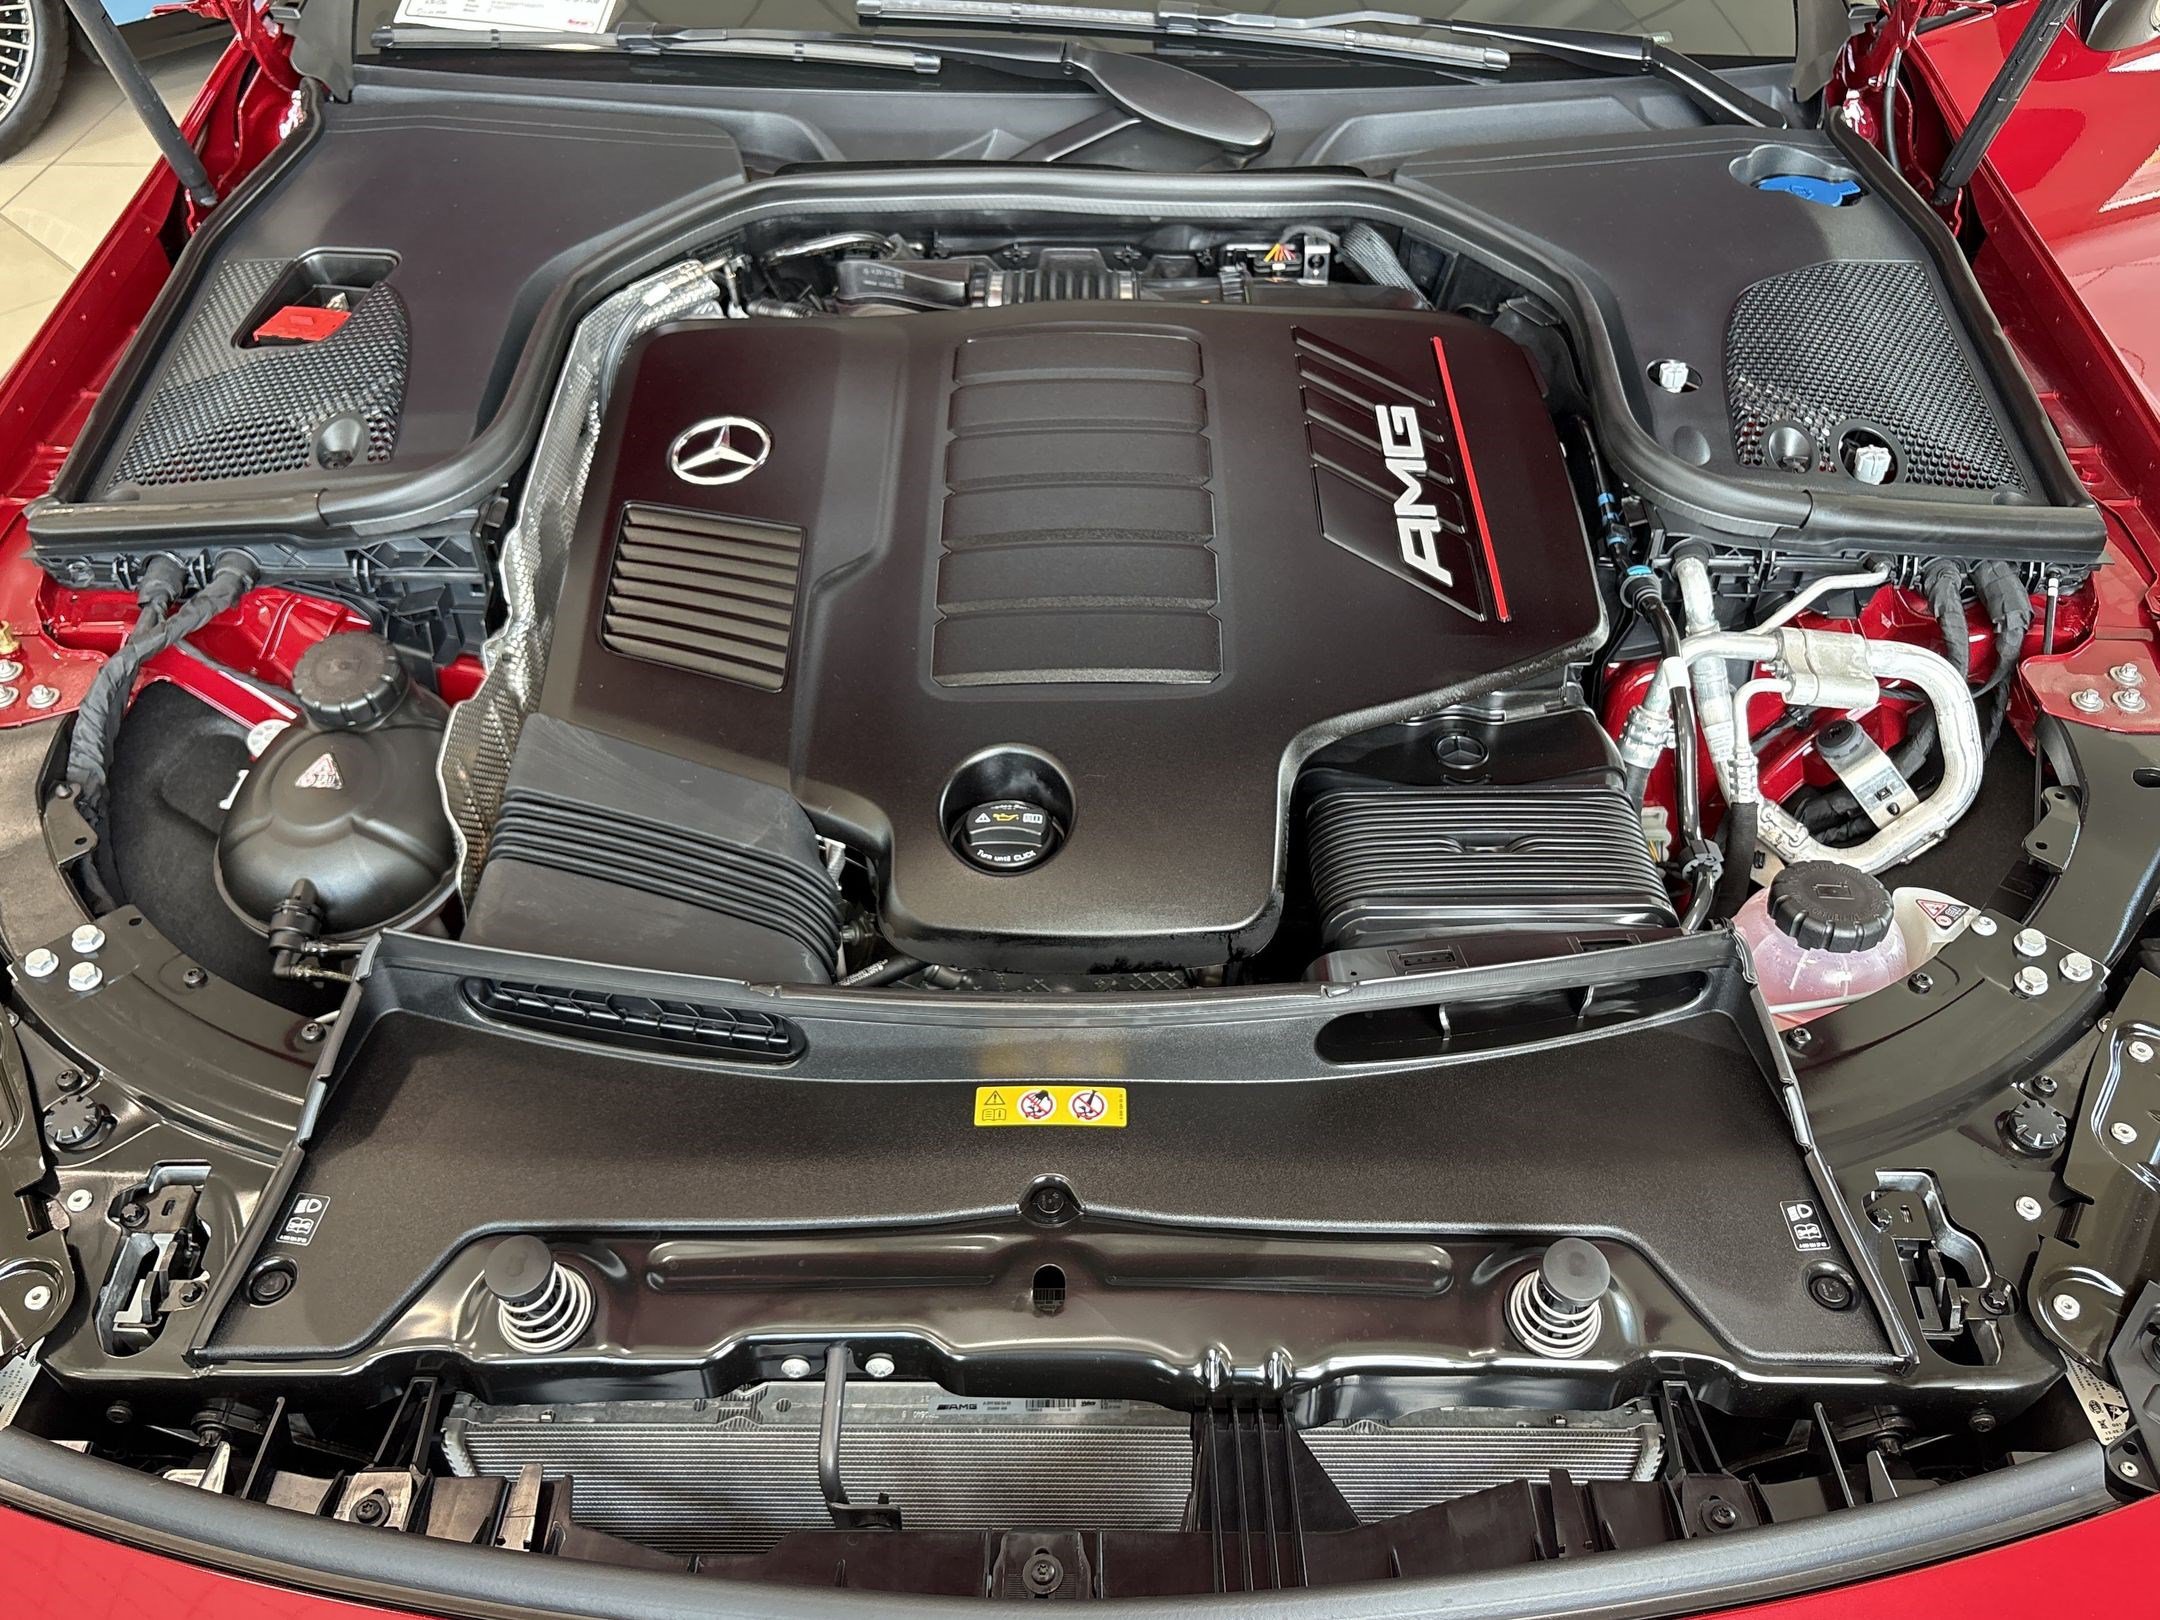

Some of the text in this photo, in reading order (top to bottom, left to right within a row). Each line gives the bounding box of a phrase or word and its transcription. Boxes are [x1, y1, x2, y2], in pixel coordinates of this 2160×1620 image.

[1375, 405, 1453, 587] AMG
[976, 849, 993, 860] Turn
[1013, 850, 1037, 861] CLICK
